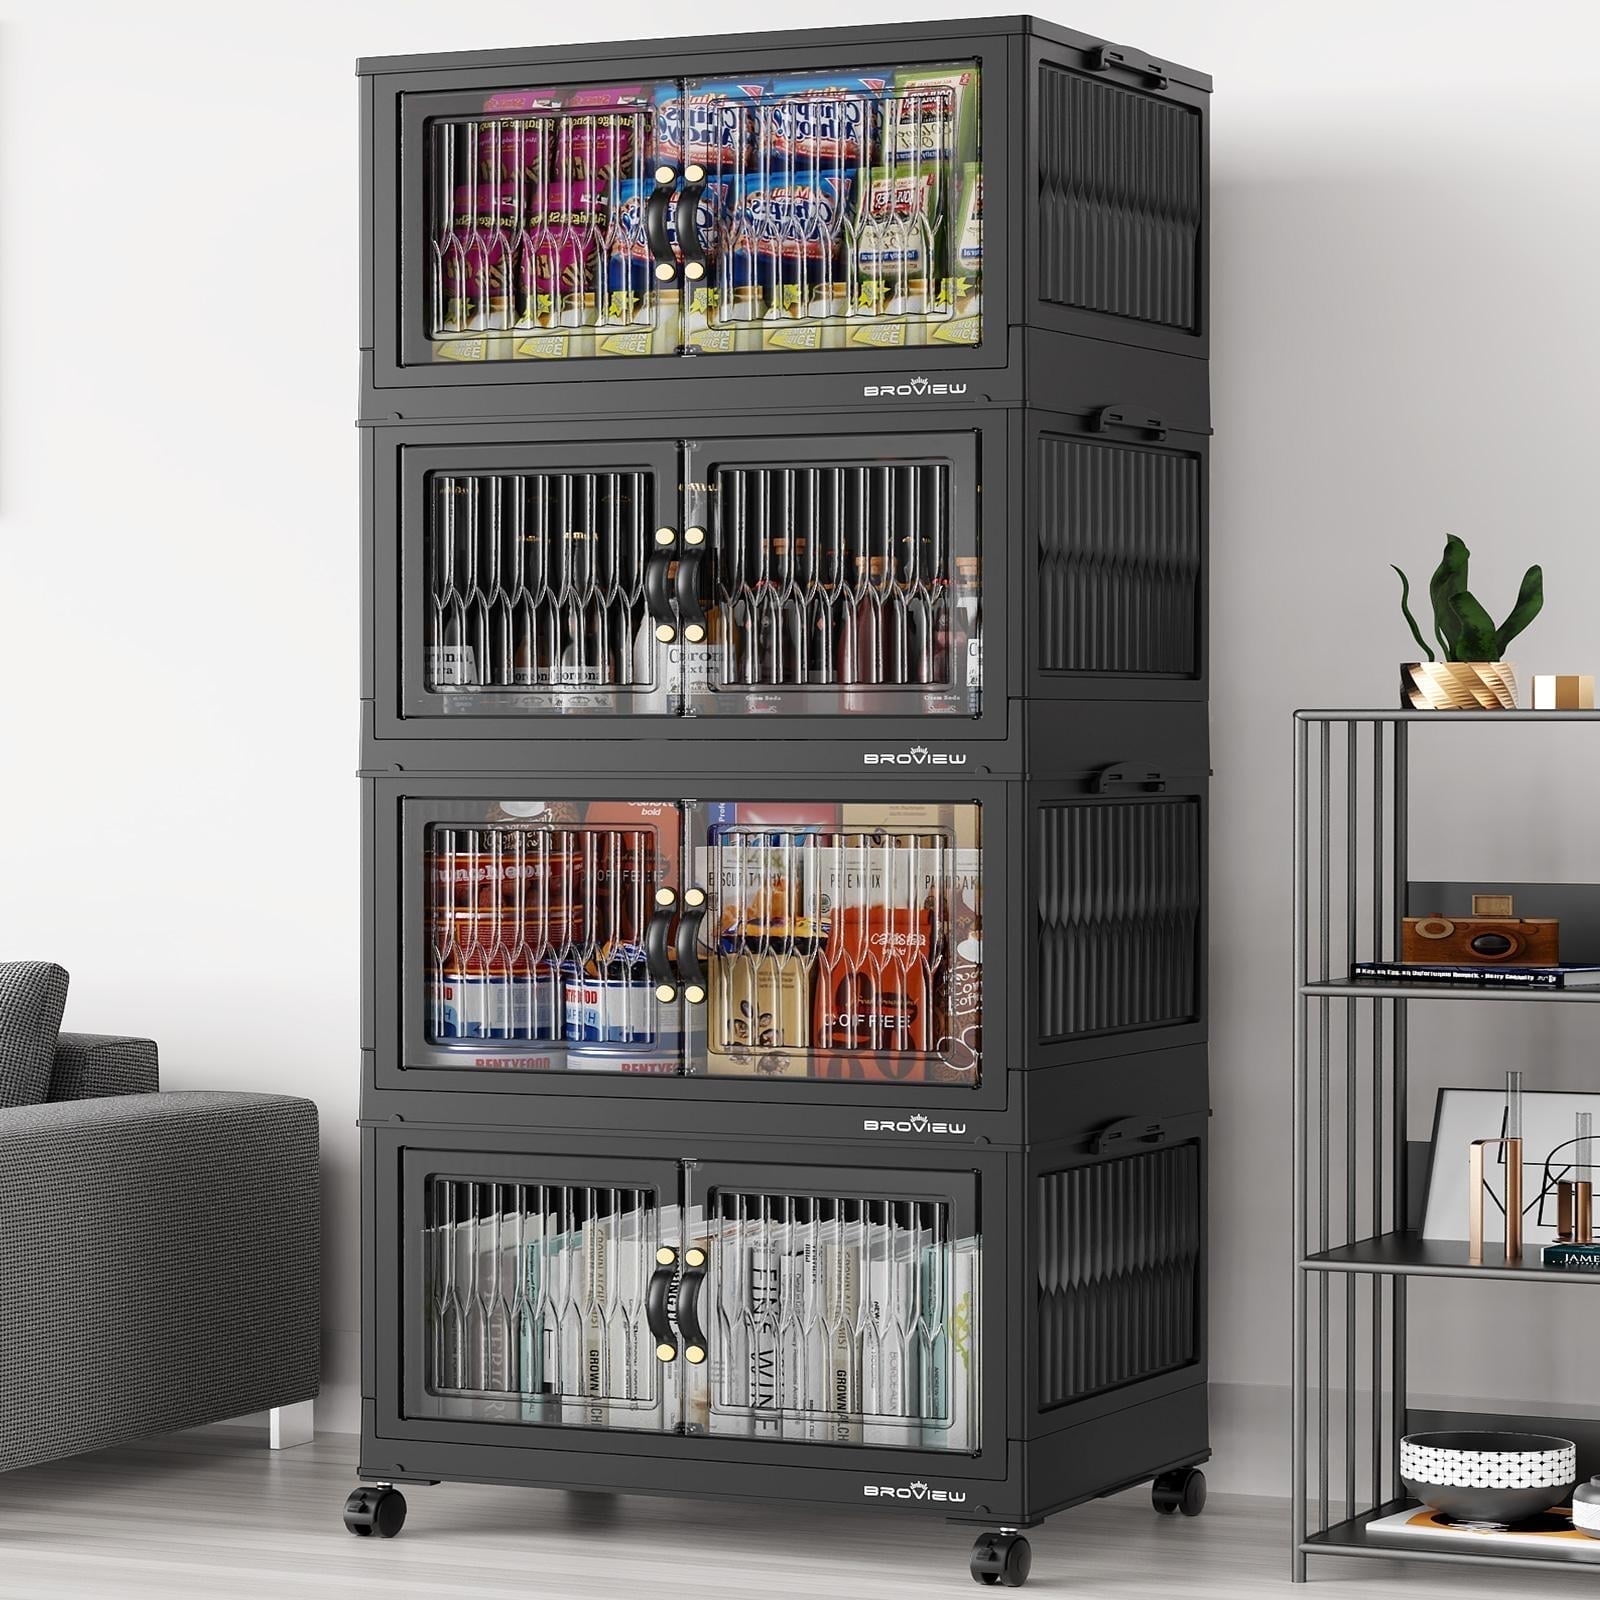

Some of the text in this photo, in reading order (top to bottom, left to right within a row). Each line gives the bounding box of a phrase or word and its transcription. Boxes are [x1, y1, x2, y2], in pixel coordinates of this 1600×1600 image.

[863, 380, 967, 397] BROVIEW
[863, 750, 966, 765] BROVIEW
[641, 807, 661, 816] bold
[824, 1013, 911, 1029] COFFEE
[863, 1117, 966, 1134] BROVIEW
[590, 1349, 600, 1391] GROWN
[836, 1369, 848, 1410] GROWN
[863, 1483, 966, 1502] BROVIEW
